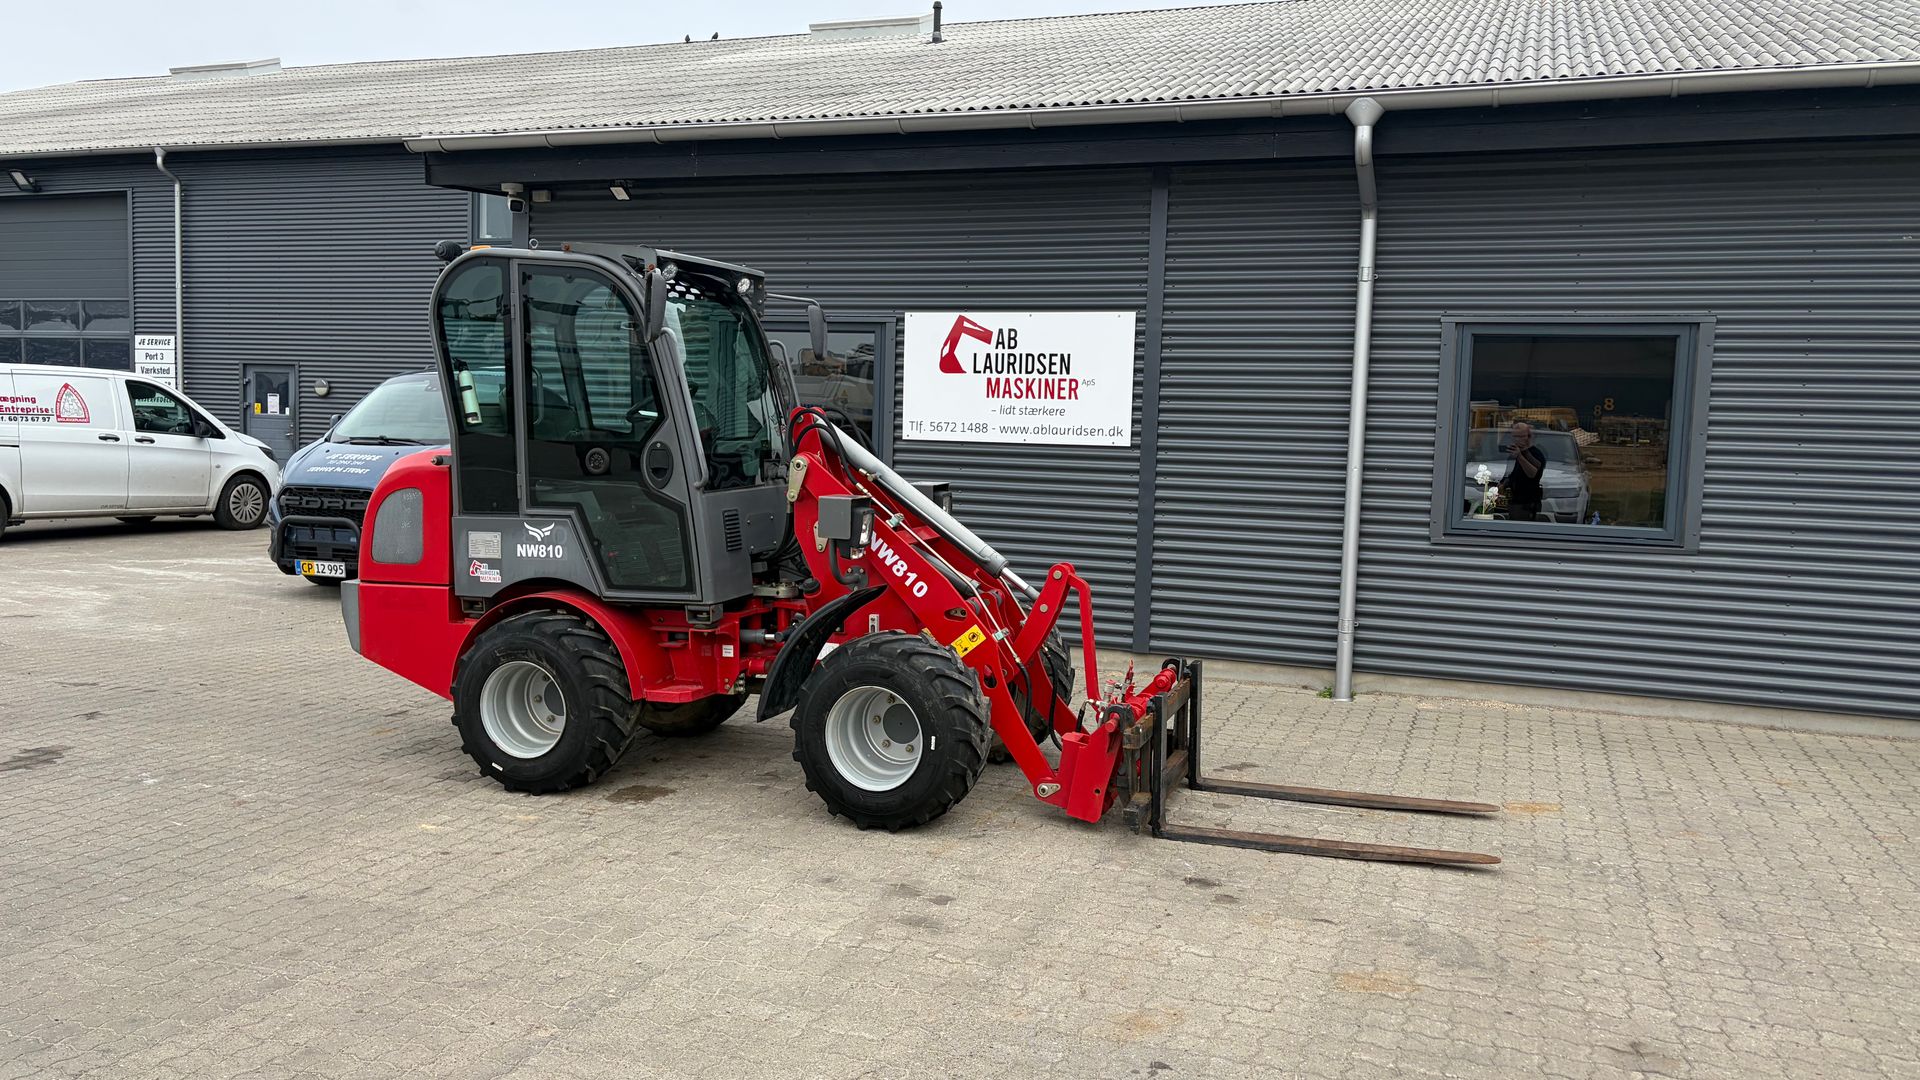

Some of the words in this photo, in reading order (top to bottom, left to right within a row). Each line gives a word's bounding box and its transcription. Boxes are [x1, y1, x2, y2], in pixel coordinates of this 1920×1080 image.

[138, 338, 146, 346] JE
[147, 338, 171, 346] SERVICE
[995, 328, 1018, 350] AB
[145, 352, 158, 361] Port
[160, 352, 164, 361] 3
[973, 352, 1071, 375] LAURIDSEN
[141, 365, 171, 375] Værksted
[986, 377, 1079, 400] MASKINER
[1081, 378, 1096, 387] ApS
[999, 405, 1016, 415] lidt
[1018, 405, 1066, 416] stærkere
[909, 420, 926, 434] Tlf.
[929, 421, 957, 433] 5672
[960, 422, 988, 434] 1488
[999, 424, 1124, 437] www.ablauridsen.dk
[280, 495, 369, 510] FORD
[516, 543, 563, 559] NW810
[301, 562, 314, 573] CP
[315, 563, 327, 574] 12
[327, 564, 344, 575] 995
